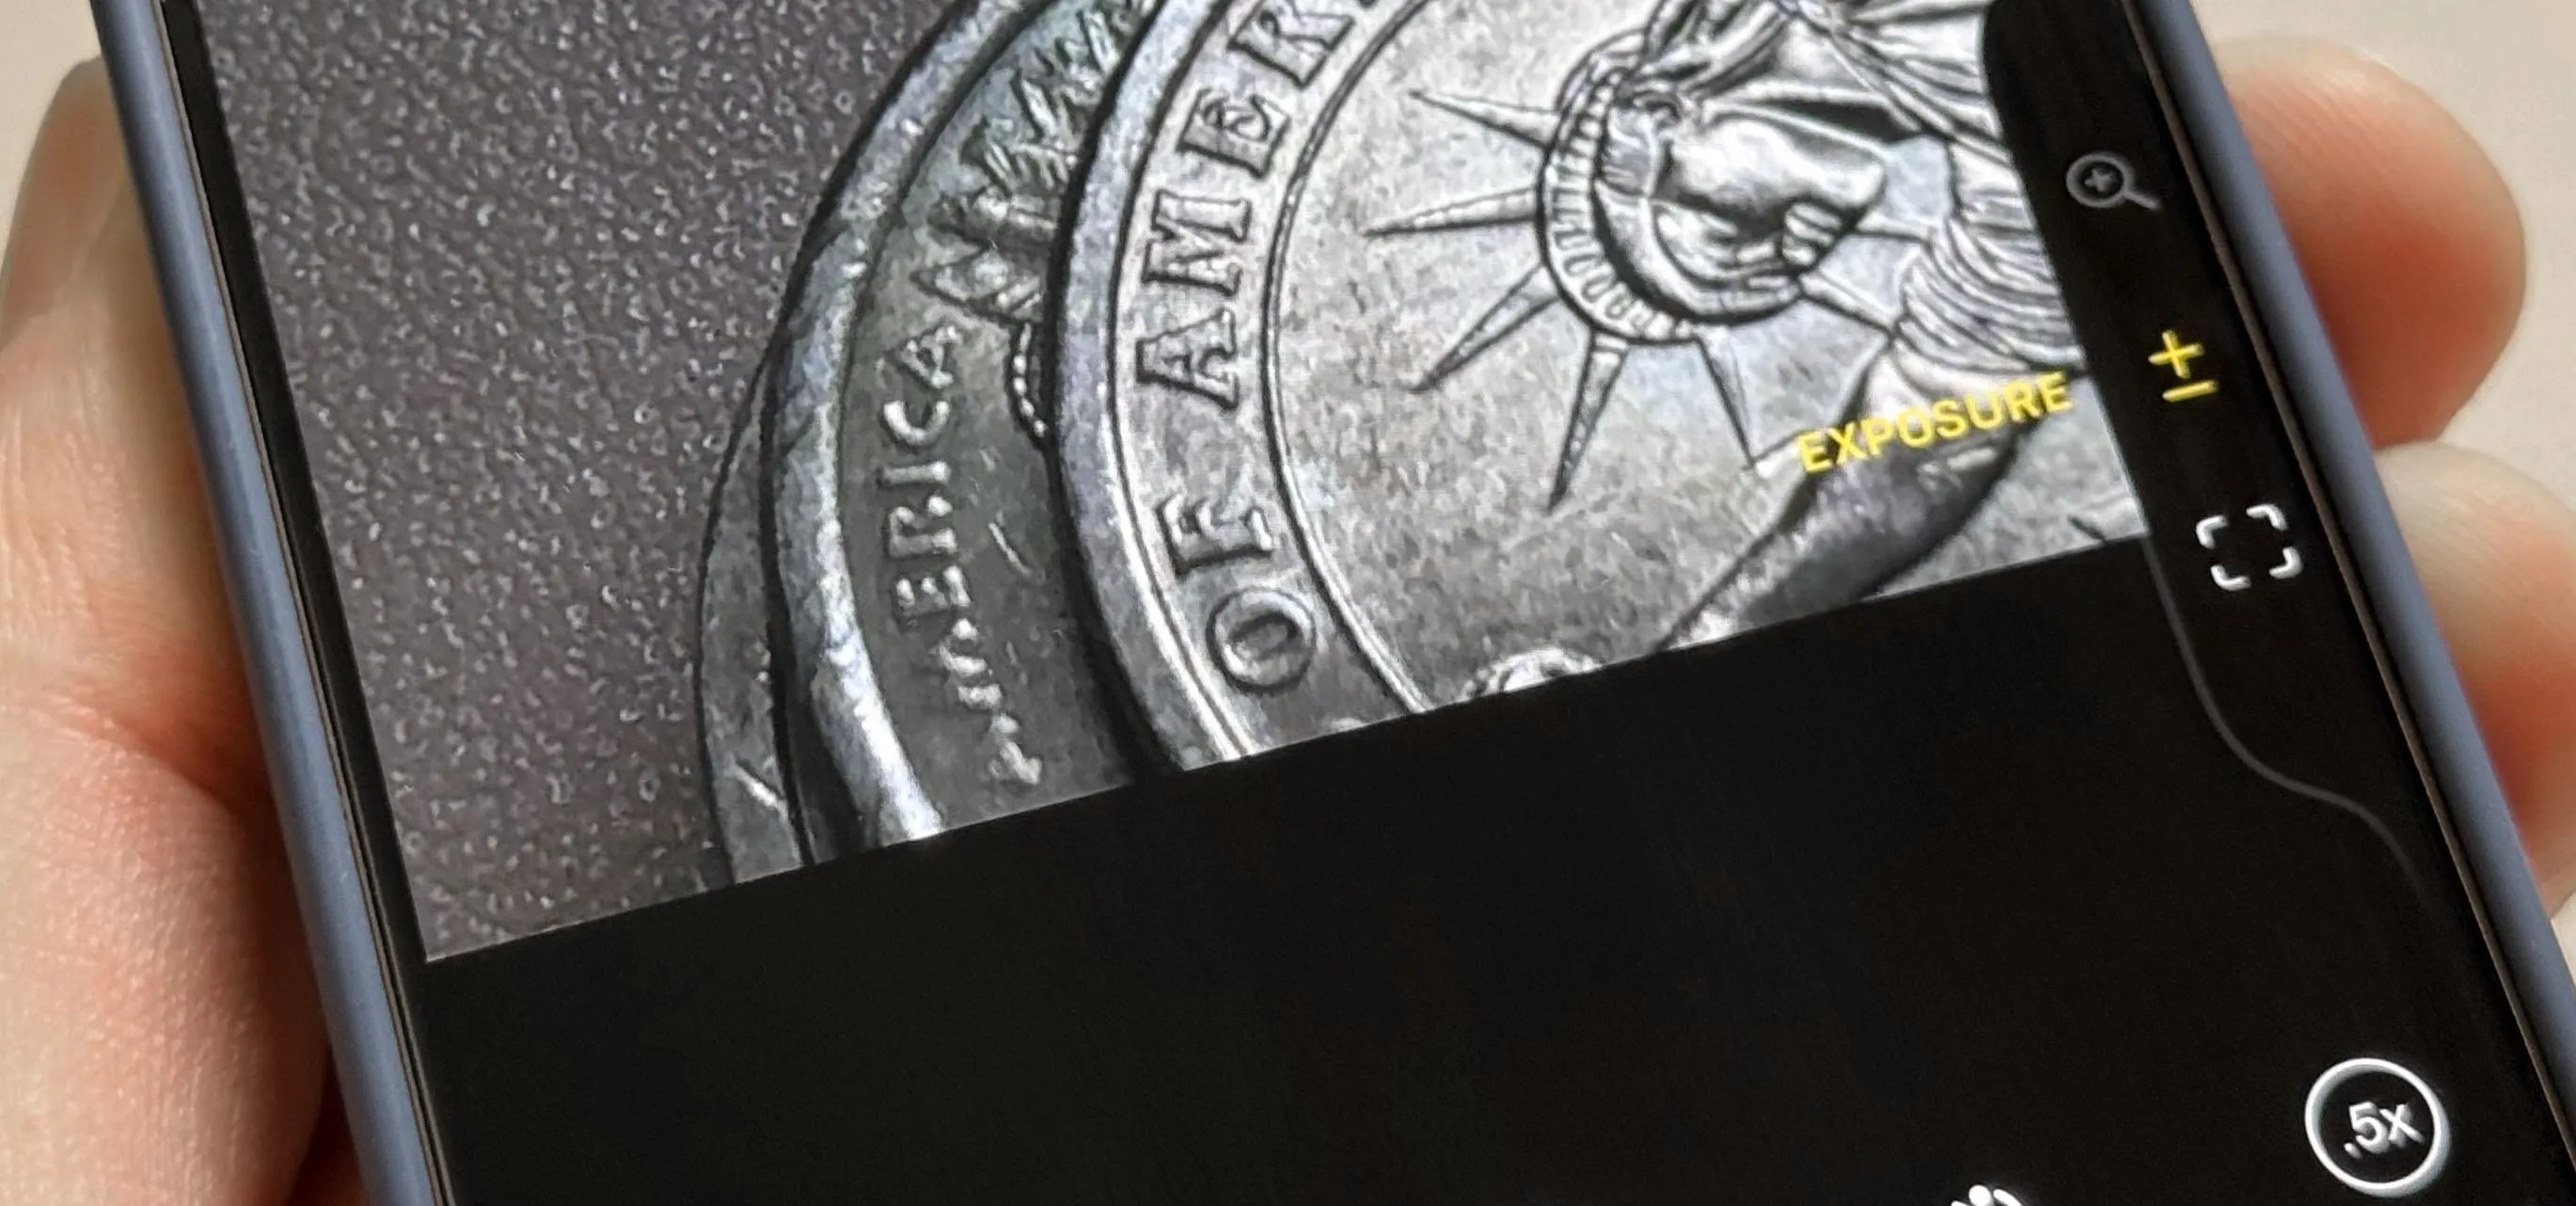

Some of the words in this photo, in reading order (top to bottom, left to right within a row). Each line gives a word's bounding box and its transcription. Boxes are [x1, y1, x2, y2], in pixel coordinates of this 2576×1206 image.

[1137, 0, 1380, 410] AMER
[1795, 370, 2074, 474] EXPOSURE
[1157, 493, 1316, 696] OF
